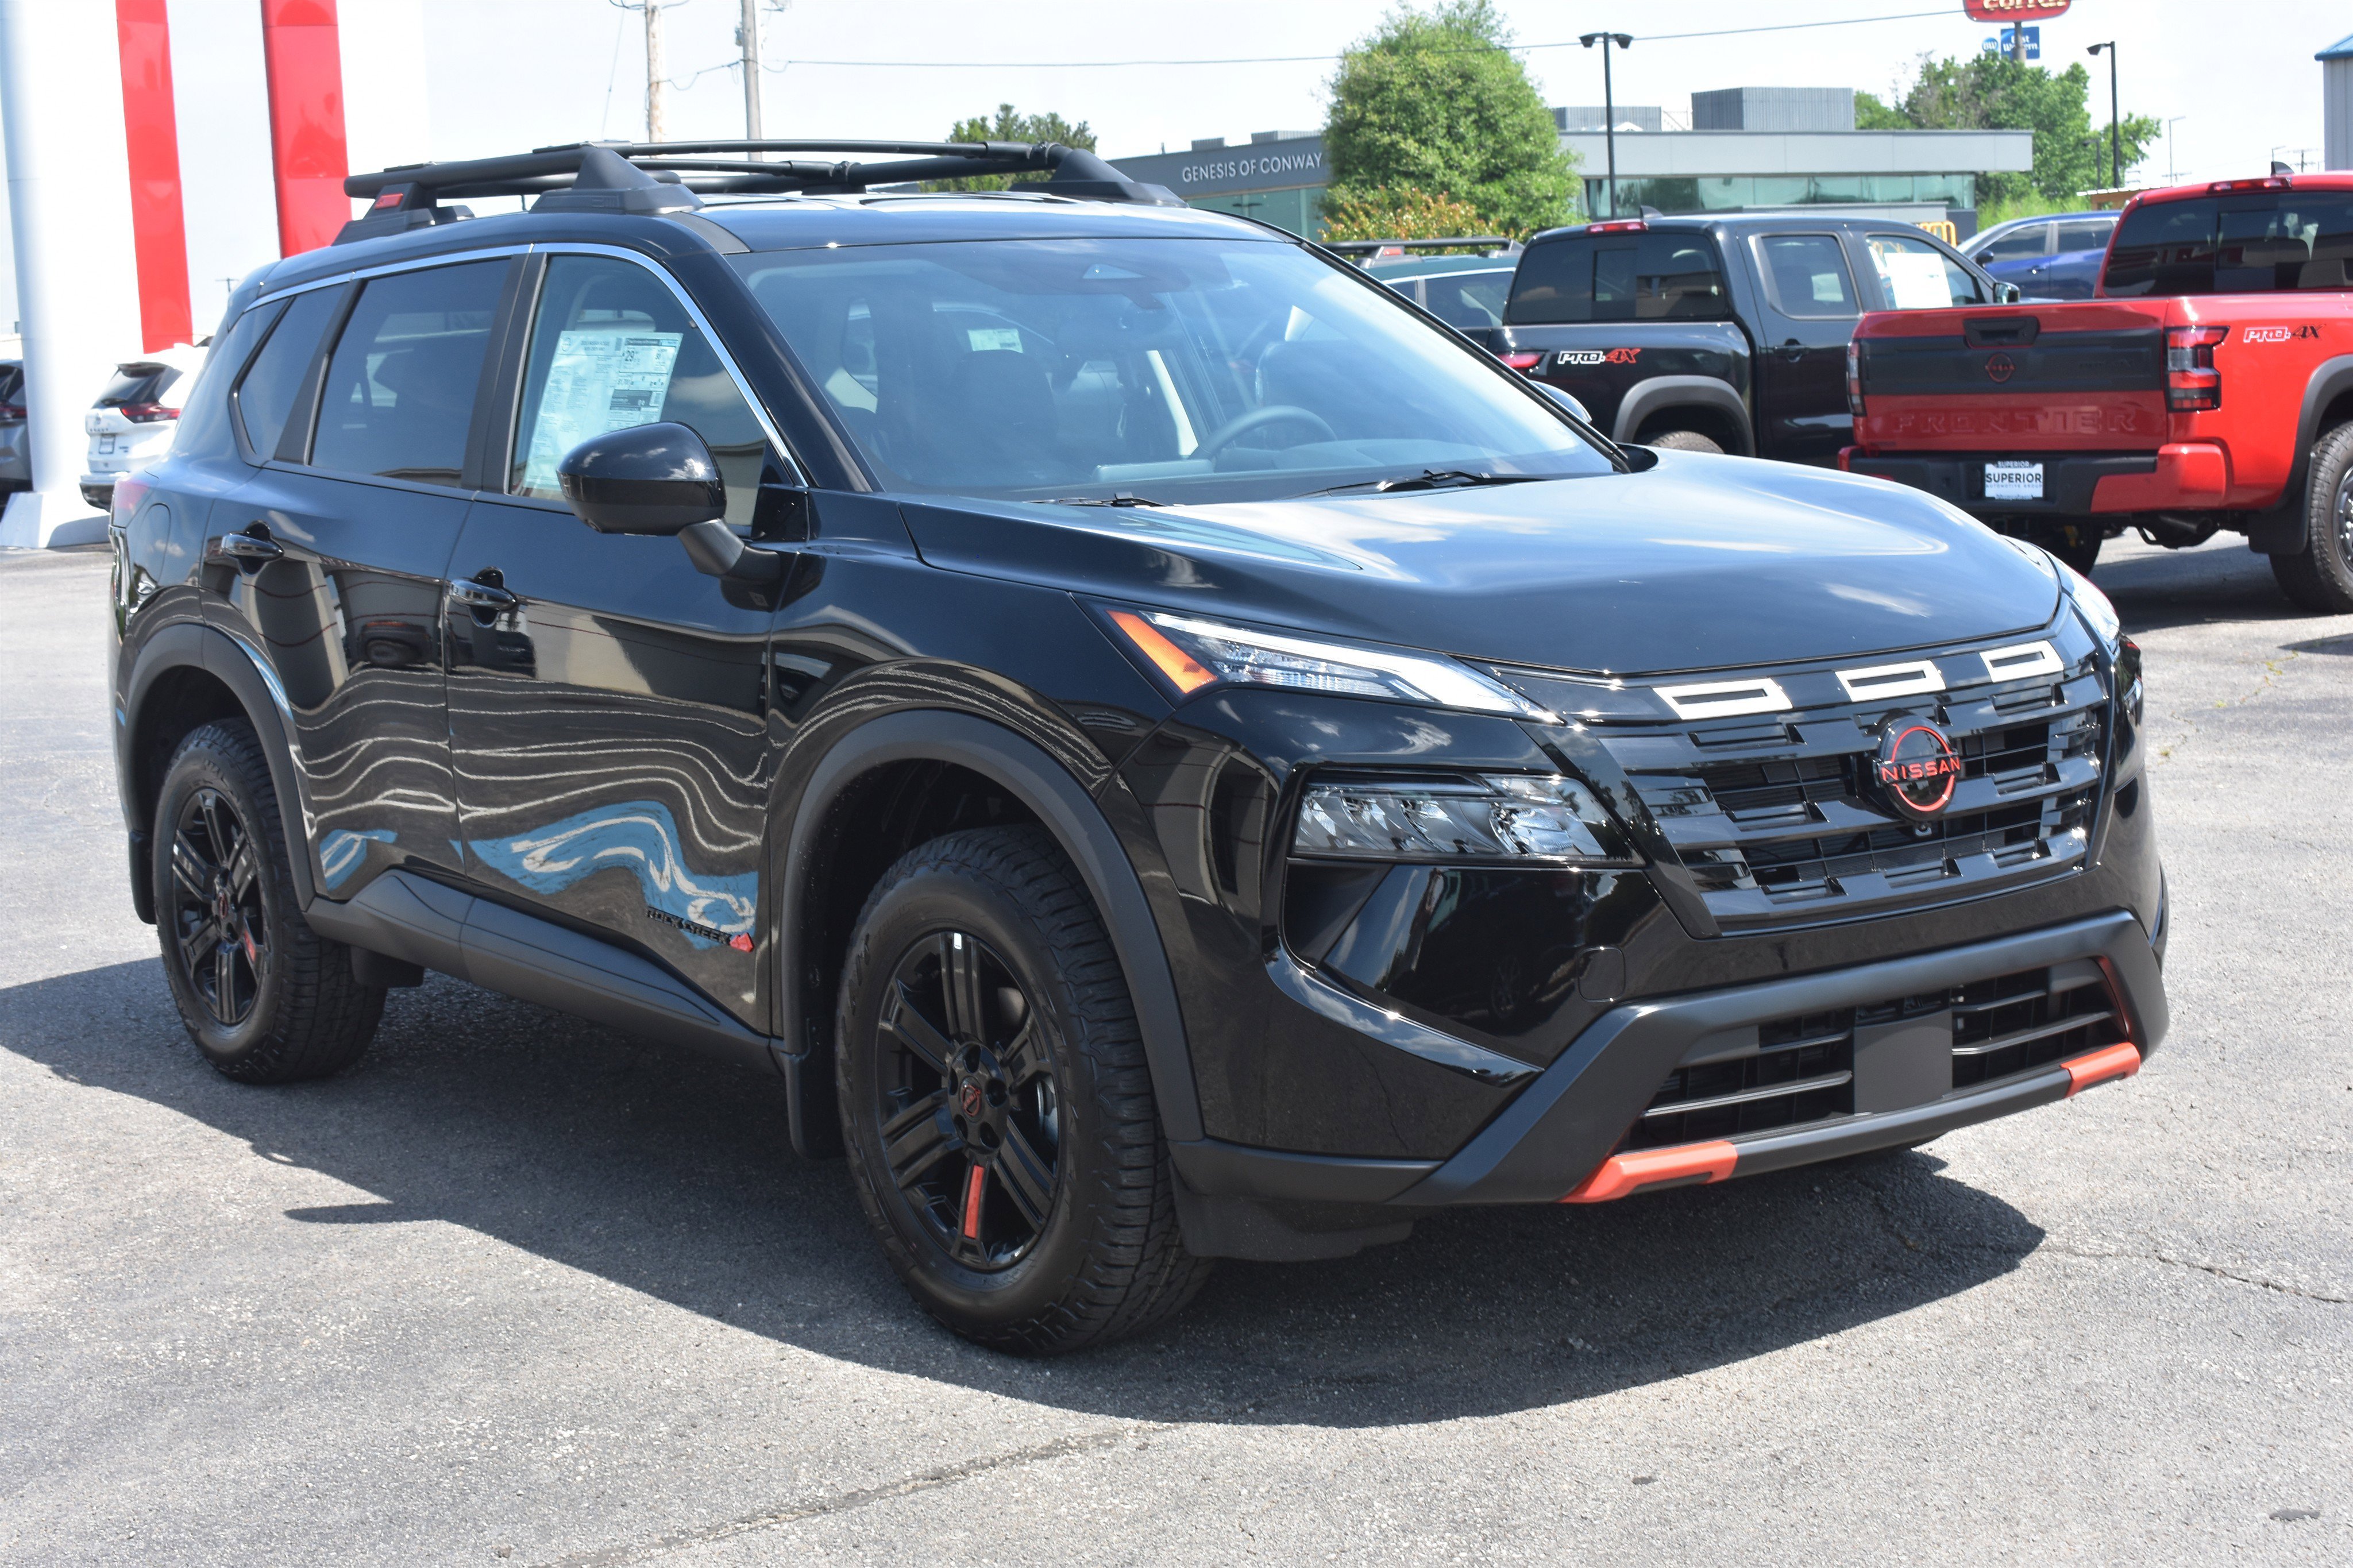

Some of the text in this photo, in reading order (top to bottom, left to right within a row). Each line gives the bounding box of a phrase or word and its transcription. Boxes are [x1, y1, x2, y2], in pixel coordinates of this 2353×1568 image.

[1182, 152, 1322, 182] GENESIS OF CONWAY
[1891, 407, 2138, 434] FRONTIER
[1985, 473, 2042, 483] SUPERIOR
[1881, 756, 1961, 781] NISSAN
